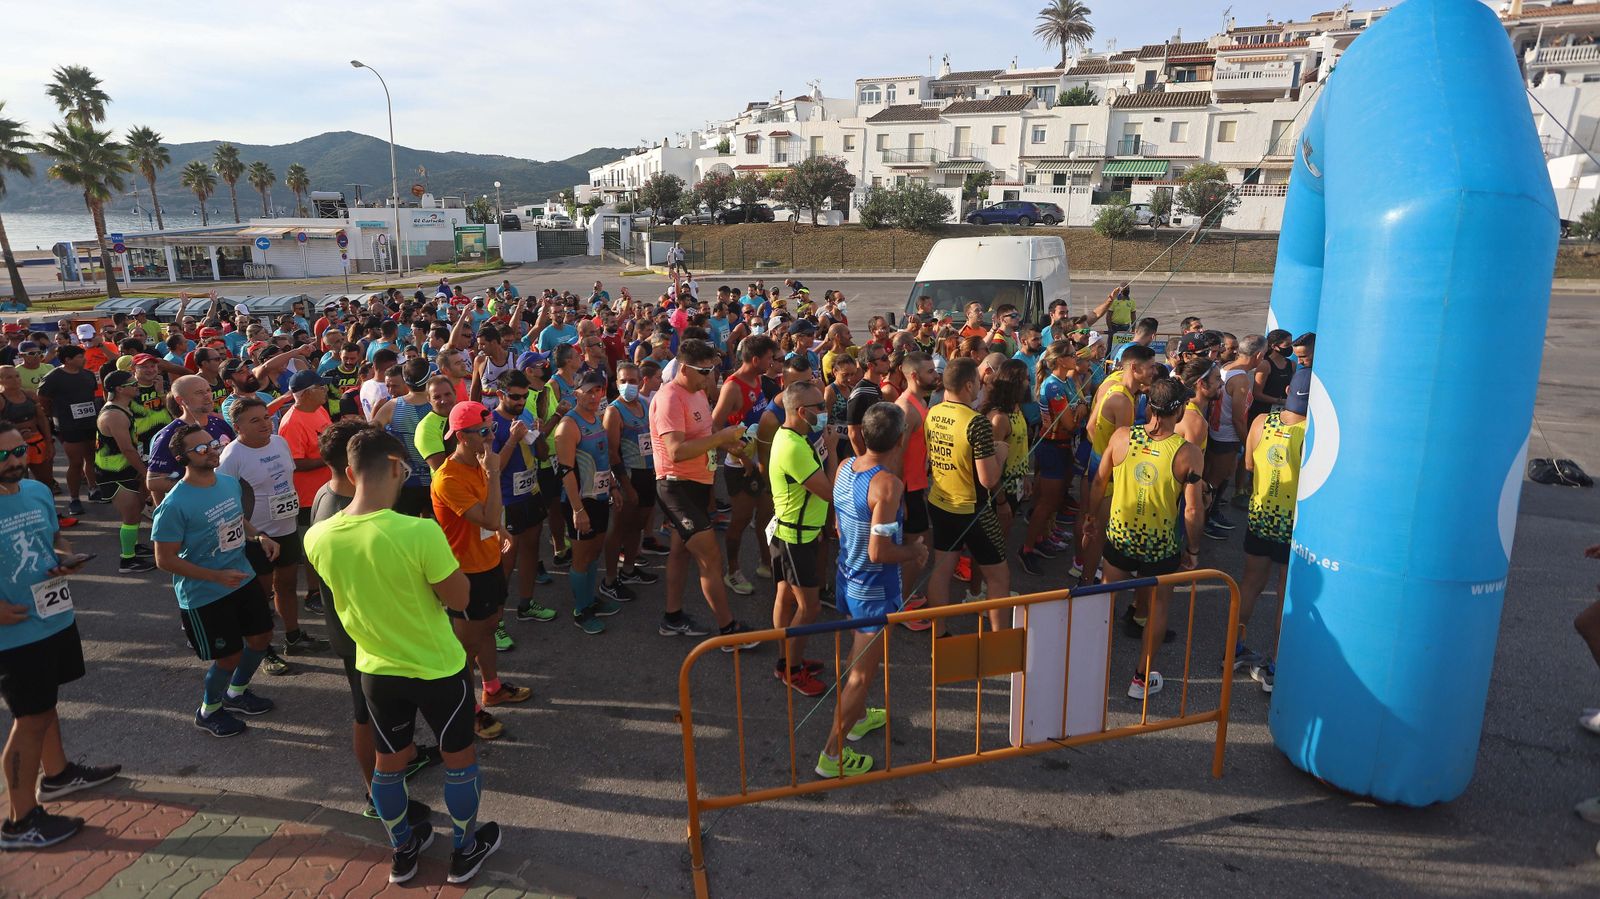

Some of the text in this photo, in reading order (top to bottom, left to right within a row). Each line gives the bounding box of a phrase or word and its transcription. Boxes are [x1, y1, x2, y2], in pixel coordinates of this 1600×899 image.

[941, 417, 955, 425] HAY
[929, 444, 952, 458] AMOR
[276, 499, 298, 514] 255
